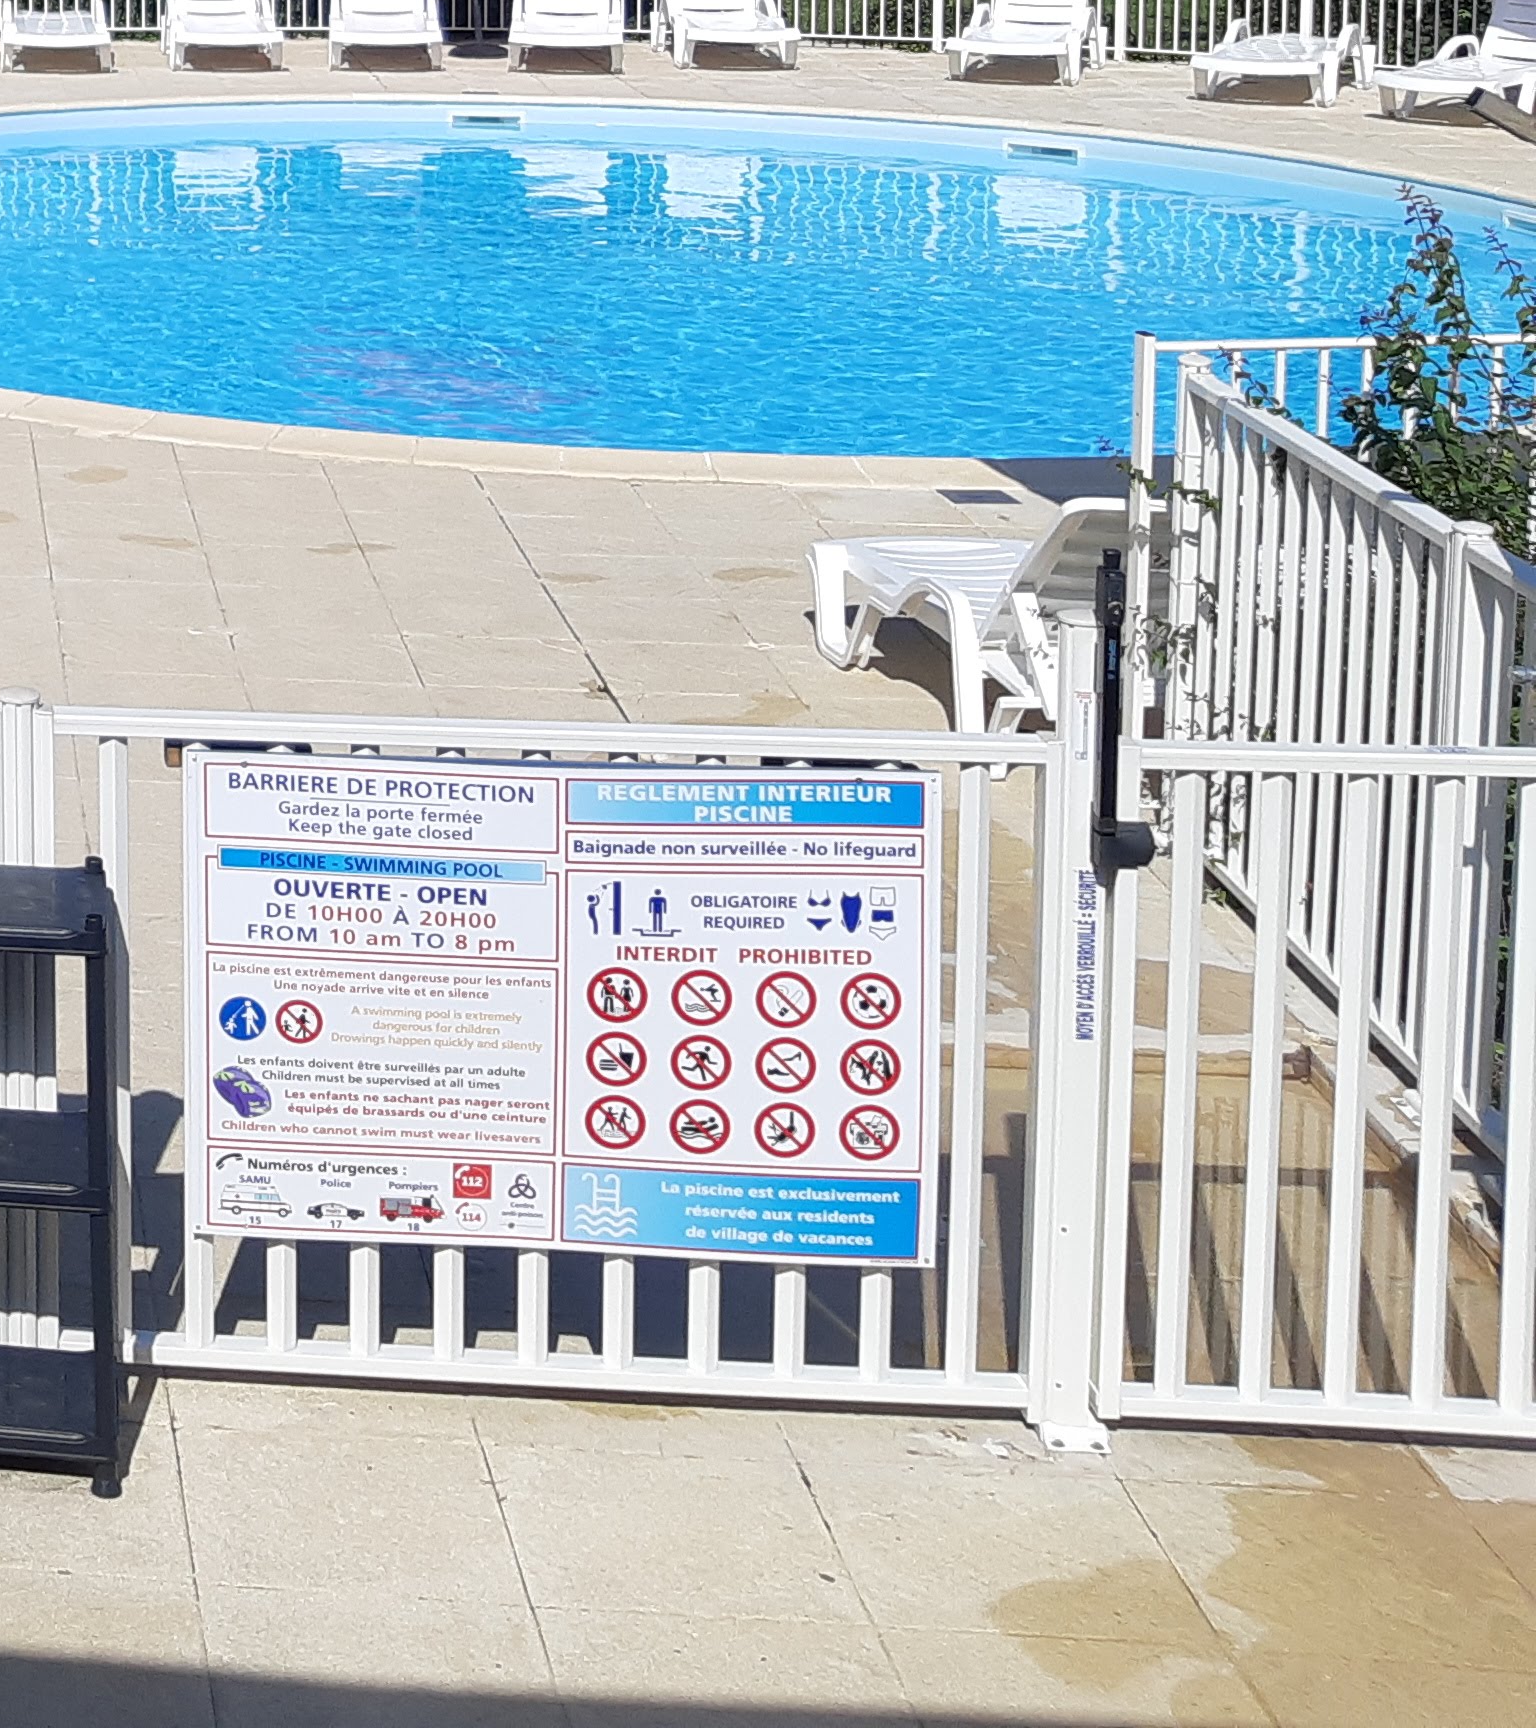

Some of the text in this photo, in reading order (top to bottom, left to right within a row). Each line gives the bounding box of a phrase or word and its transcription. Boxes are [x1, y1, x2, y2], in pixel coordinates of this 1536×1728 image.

[229, 772, 534, 803] BARRIERE DE PROTECTION
[597, 785, 891, 803] REGLEMENT INTERIEUR
[279, 801, 482, 824] Gardez la porte fermée
[694, 805, 792, 822] PISCINE
[289, 819, 472, 841] Keep the gate closed
[574, 840, 656, 857] Baignade
[662, 843, 695, 854] non
[701, 841, 786, 856] surveillée
[804, 843, 827, 855] No
[834, 842, 916, 860] lifeguard
[260, 852, 326, 869] PISCINE
[345, 857, 446, 876] SWIMMING
[454, 863, 503, 878] POOL
[274, 879, 391, 901] OUVERTE
[418, 886, 487, 905] OPEN
[691, 895, 797, 909] OBLIGATOIRE
[266, 903, 496, 929] DE 10H00 À 20H00
[704, 917, 784, 931] REQUIRED
[248, 924, 515, 954] FROM 10 am TO 8 pm
[617, 946, 871, 965] INTERDIT PROHIBITED
[213, 962, 551, 988] La piscine est extrêmement dangereuse pour les enfants
[274, 980, 489, 999] Une noyade arrive vite et en silence
[351, 1006, 521, 1024] A swimming pool is extremely
[373, 1020, 500, 1036] dangerous for children
[1075, 1012, 1094, 1040] MOYEN
[331, 1032, 543, 1053] Drowings happen quickly and silently
[238, 1055, 525, 1078] Les enfants doivent être surveillés par un adulte
[262, 1070, 500, 1090] Children must be supervised at all times
[285, 1090, 550, 1111] Les enfants ne sachant pas nager seront
[288, 1102, 546, 1124] équipés de brassards ou d'une ceinture
[222, 1121, 541, 1144] Children who cannot swim must wear livesavers
[248, 1158, 313, 1172] Numéros
[318, 1161, 398, 1177] d'urgences
[239, 1174, 271, 1184] SAMU
[321, 1178, 351, 1188] Police
[388, 1181, 438, 1192] Pompiers
[462, 1177, 482, 1186] 112
[661, 1181, 900, 1203] La piscine est exclusivement
[249, 1216, 261, 1225] 15
[462, 1213, 481, 1221] 114
[686, 1204, 875, 1224] réservée aux residents
[330, 1220, 342, 1229] 17
[408, 1223, 419, 1231] 18
[686, 1225, 873, 1246] de village de vacances
